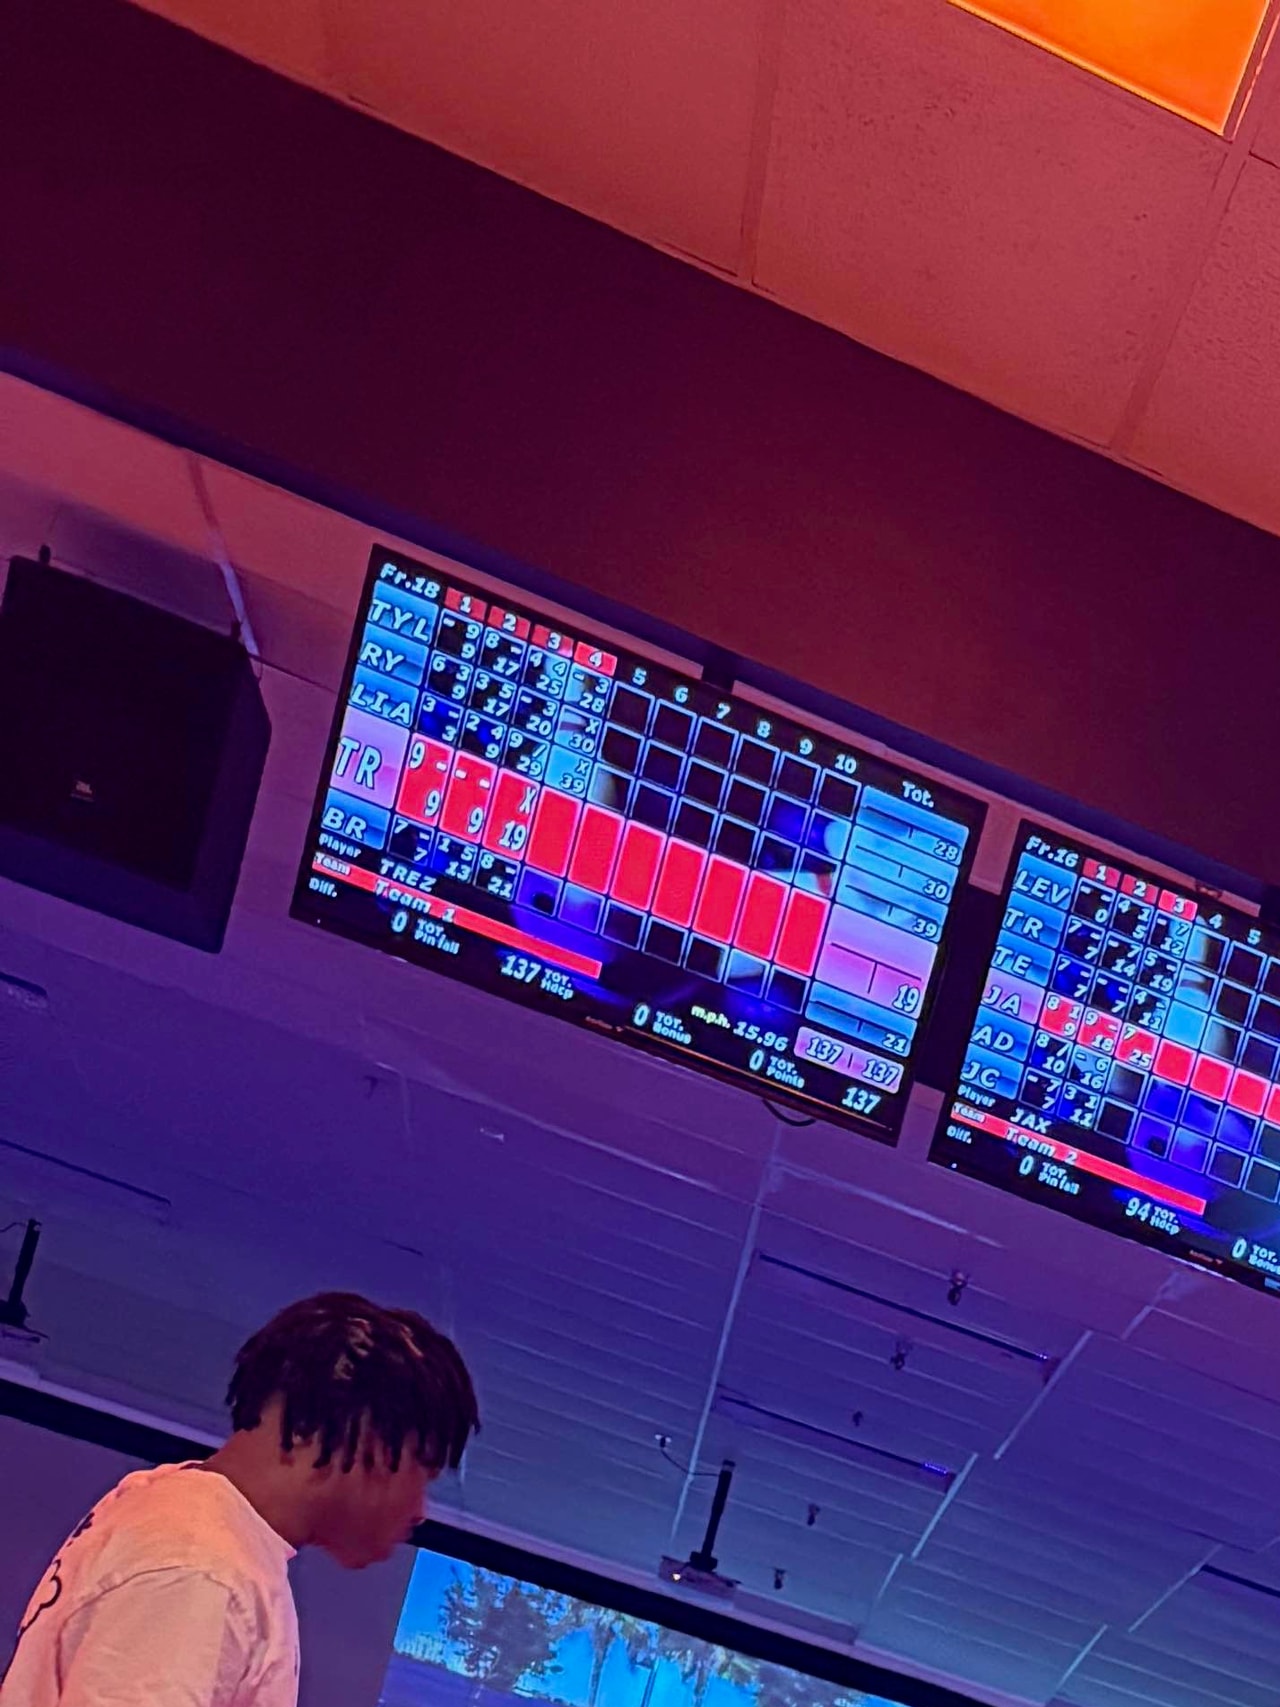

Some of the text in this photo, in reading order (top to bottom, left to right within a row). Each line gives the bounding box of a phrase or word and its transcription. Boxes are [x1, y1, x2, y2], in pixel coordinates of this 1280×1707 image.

[380, 562, 440, 599] Fr.18
[460, 596, 471, 613] 1
[503, 613, 516, 631] 2
[548, 632, 561, 649] 3
[590, 651, 602, 668] 4
[632, 668, 647, 686] 5
[674, 685, 689, 703] 6
[716, 703, 731, 720] 7
[756, 720, 772, 738] 8
[800, 739, 813, 755] 9
[835, 754, 857, 774] 10
[360, 641, 948, 900] RY 30
[370, 599, 958, 862] TYL 28
[350, 682, 938, 938] LIA 39
[334, 736, 920, 1012] TR 19
[1004, 908, 1044, 939] TR
[1012, 870, 1070, 904] LEV
[1025, 835, 1079, 868] Fr.16
[1096, 866, 1107, 881] 1
[1135, 881, 1146, 896] 2
[1174, 898, 1185, 913] 3
[1209, 913, 1224, 929] 4
[1247, 929, 1261, 945] 5
[322, 806, 907, 1053] BR 21
[380, 858, 436, 892] TREZ
[805, 1037, 844, 1065] 137
[860, 1059, 899, 1086] 137
[994, 948, 1032, 975] TE
[500, 954, 881, 1114] 137 137
[972, 1026, 1014, 1051] AD
[982, 985, 1020, 1016] JA
[961, 1061, 1000, 1088] JC
[1010, 1108, 1051, 1134] JAX
[1125, 1197, 1150, 1222] 94
